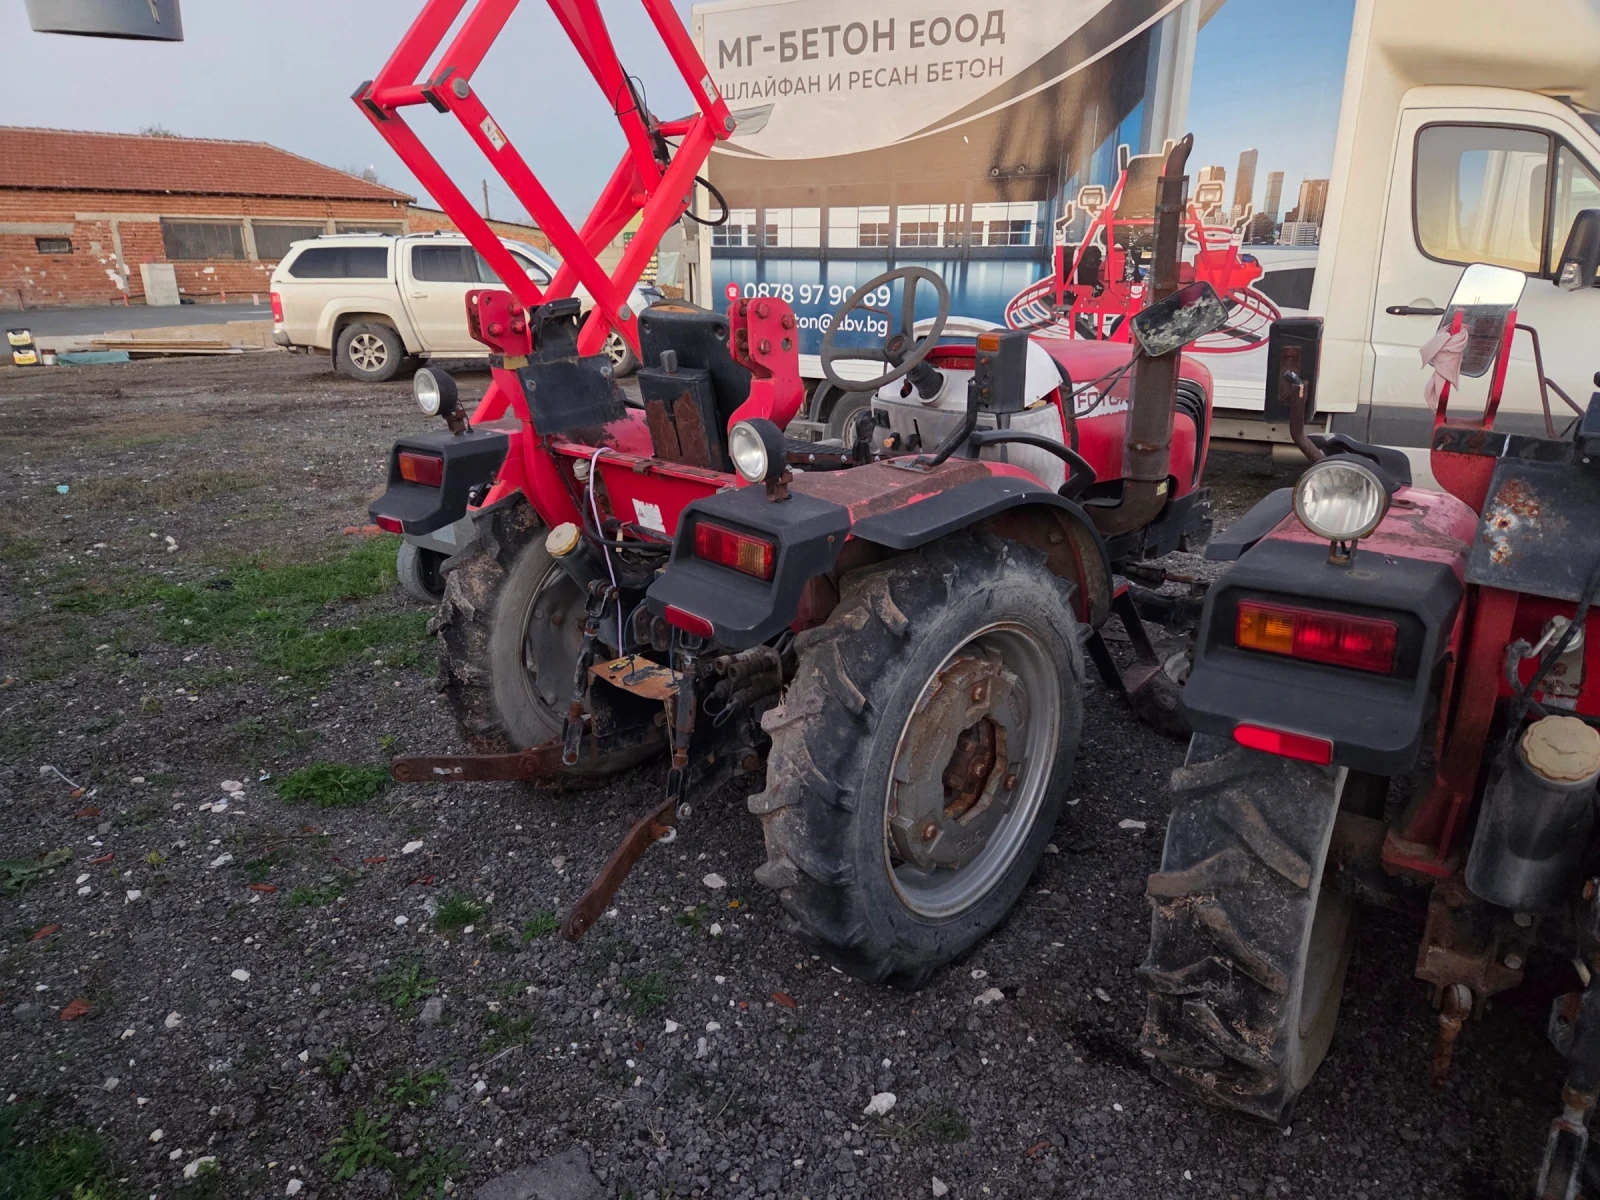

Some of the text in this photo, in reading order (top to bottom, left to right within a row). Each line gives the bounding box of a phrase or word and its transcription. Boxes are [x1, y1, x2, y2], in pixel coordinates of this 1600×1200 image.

[718, 9, 1006, 69] МГ-БЕТОН ЕООД
[719, 56, 1004, 101] ШЛАЙФАН И РЕСАН БЕТОН
[743, 282, 794, 304] 0878
[799, 284, 824, 304] 97
[829, 285, 857, 306] 90
